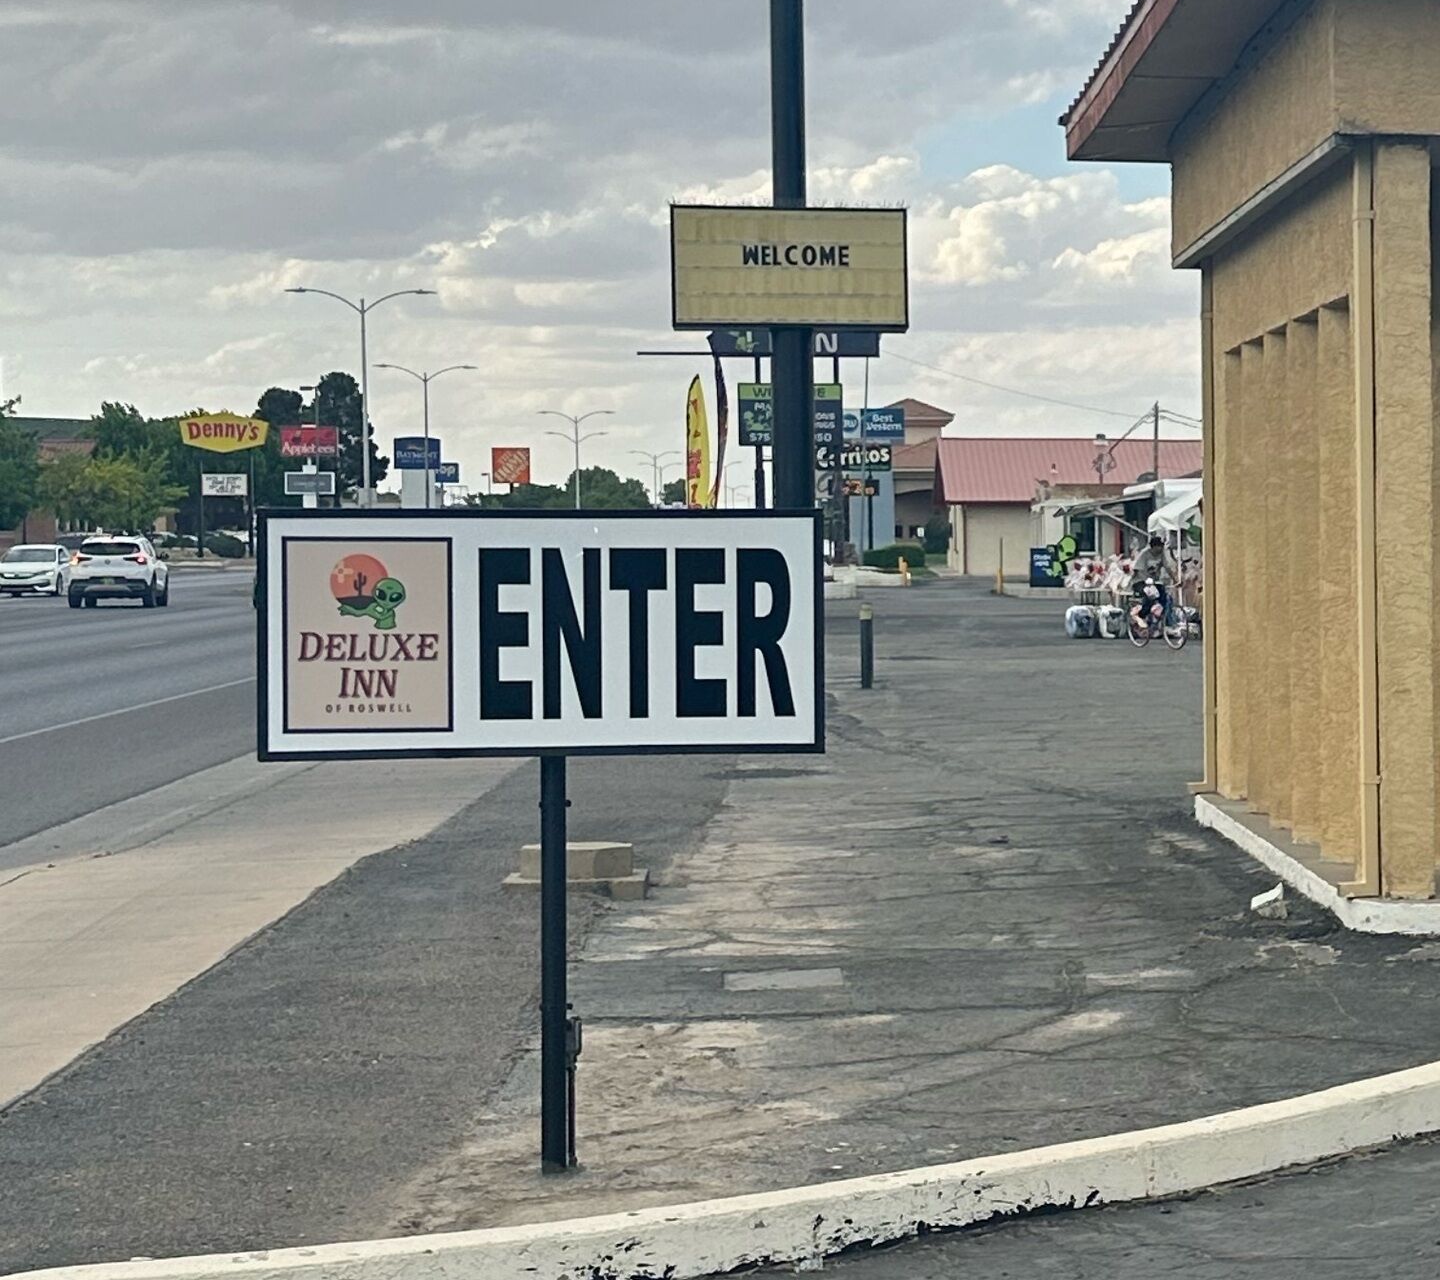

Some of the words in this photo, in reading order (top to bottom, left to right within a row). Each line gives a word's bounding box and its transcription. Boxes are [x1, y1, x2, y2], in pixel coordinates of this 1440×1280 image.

[742, 244, 850, 266] WELCOME
[872, 413, 894, 422] Best
[187, 421, 260, 442] Denny's
[478, 547, 796, 720] ENTER
[298, 631, 439, 662] DELUXE
[338, 667, 399, 698] INN
[325, 704, 342, 713] OF
[348, 703, 412, 713] ROSWELL
